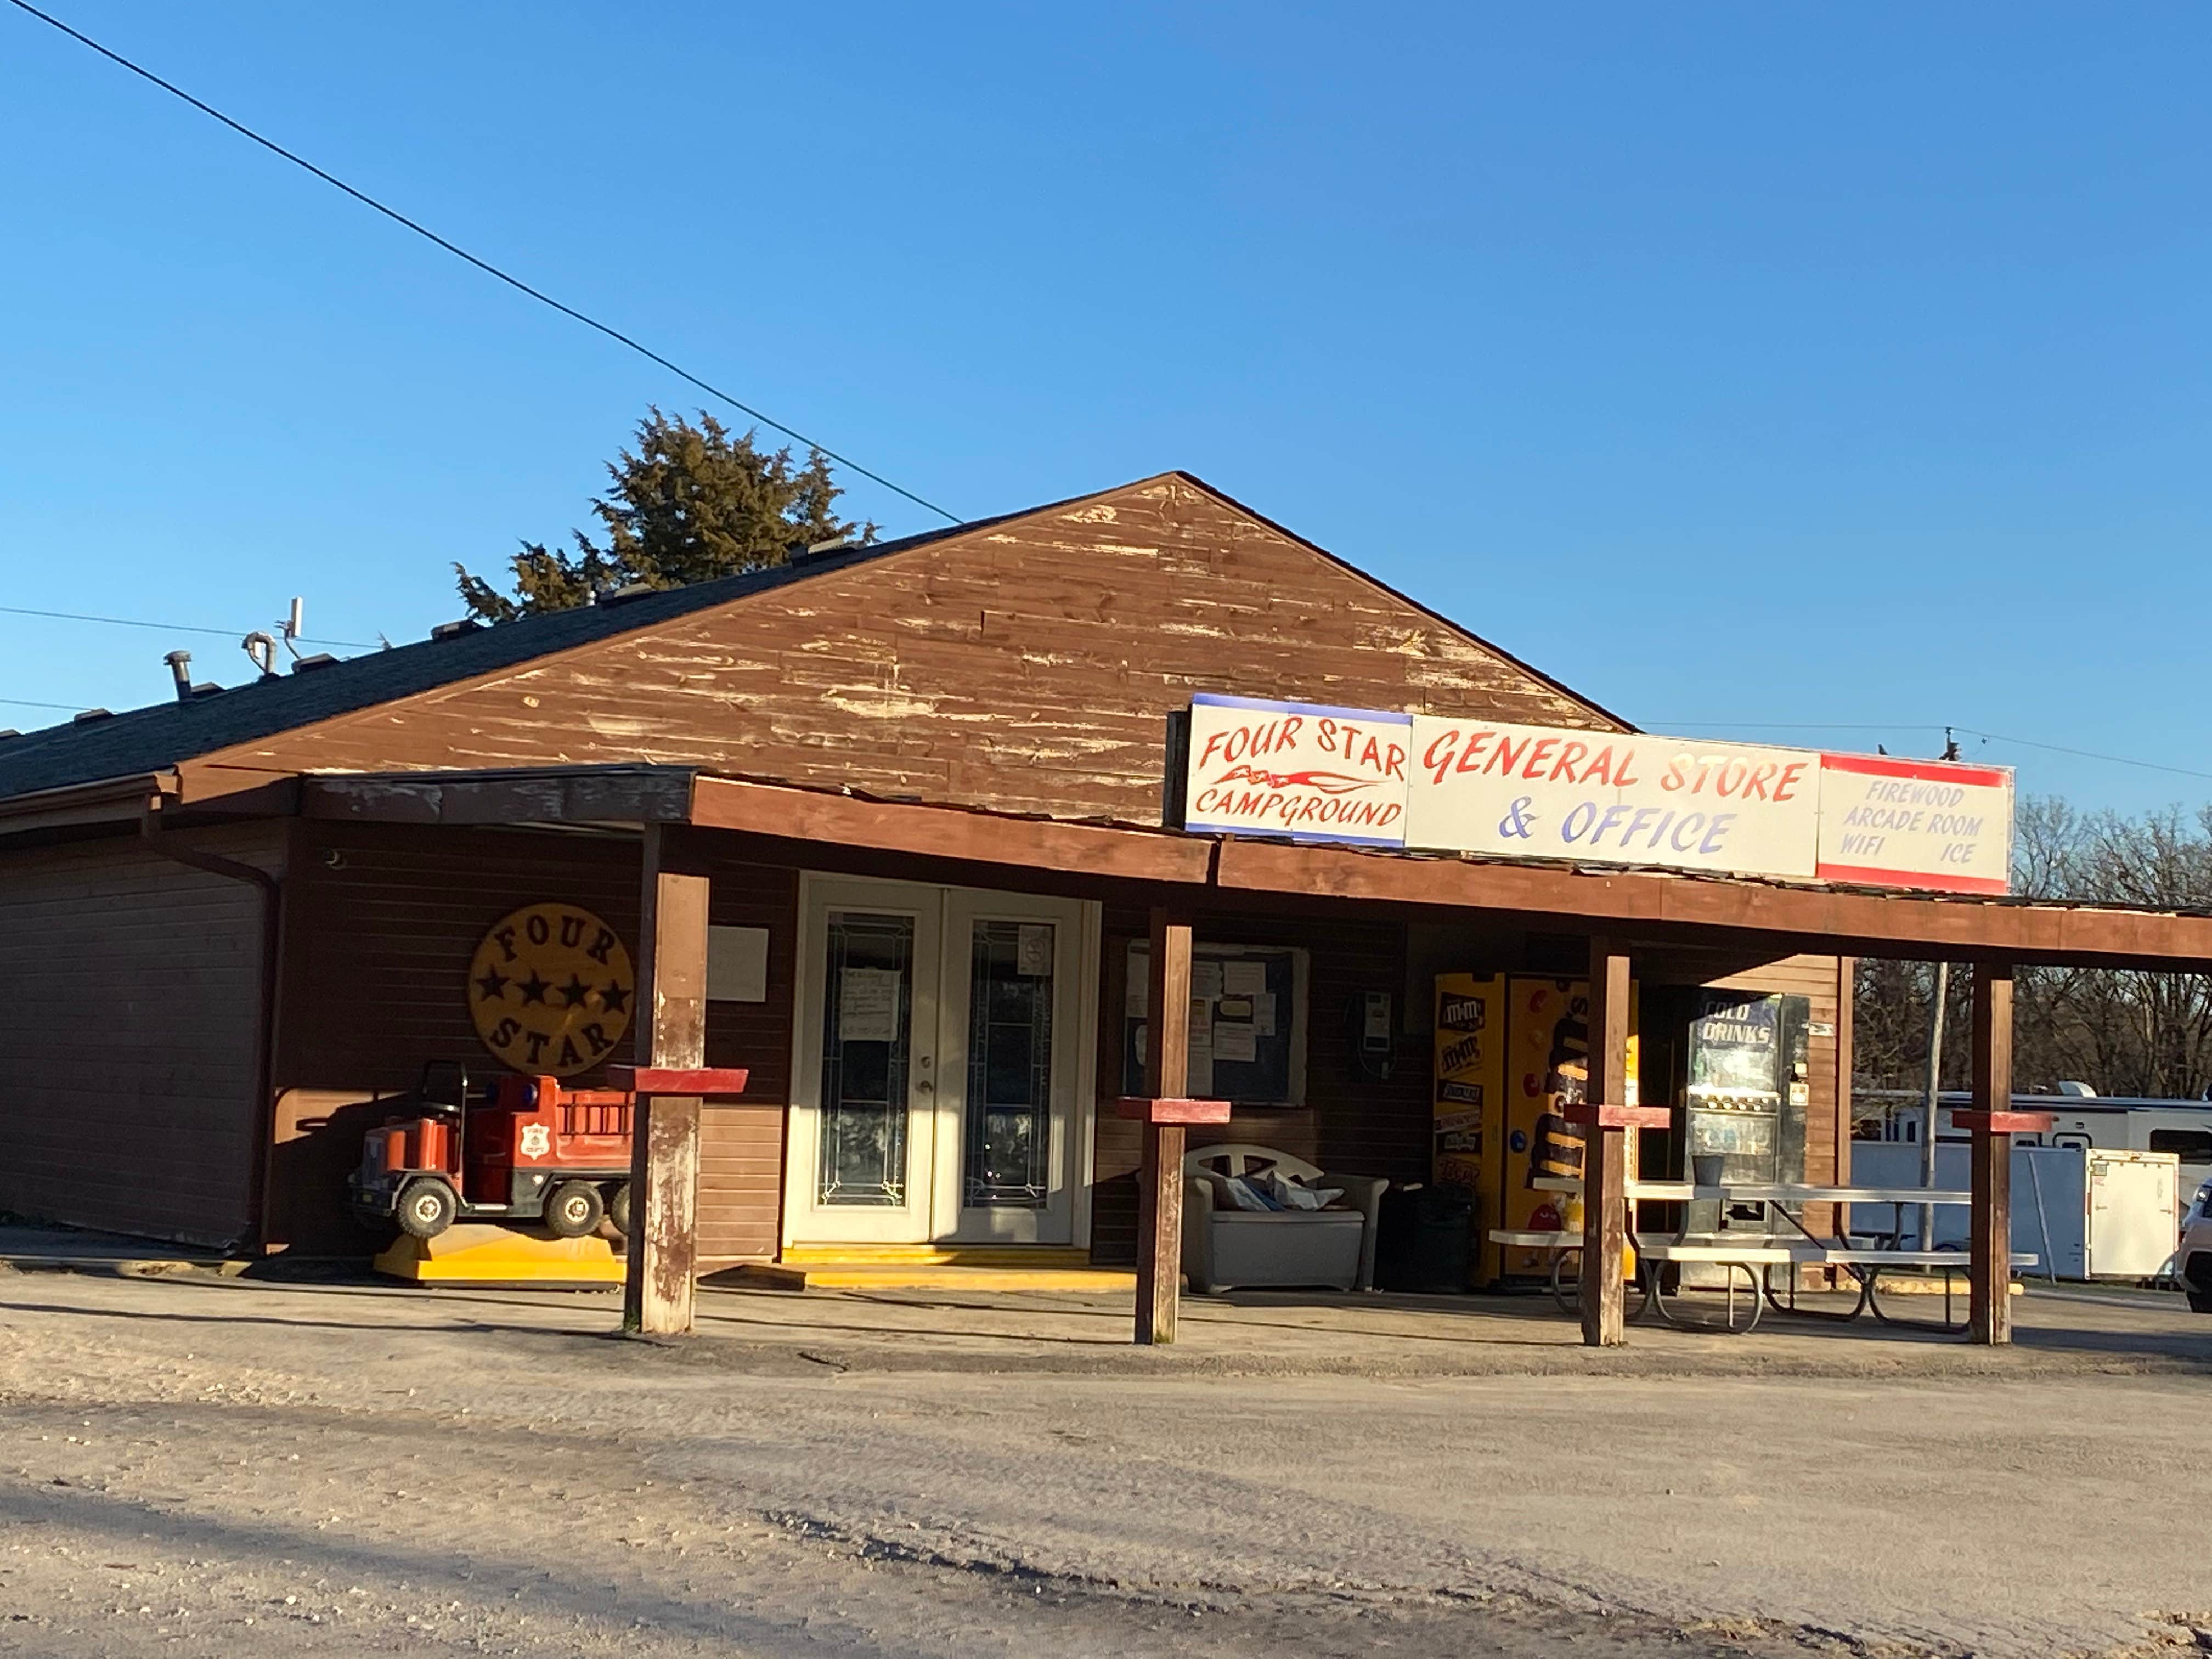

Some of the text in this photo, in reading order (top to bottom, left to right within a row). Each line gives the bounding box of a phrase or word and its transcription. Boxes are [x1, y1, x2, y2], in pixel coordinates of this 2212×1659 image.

[1199, 716, 1406, 783] FOUR STAR
[1424, 730, 1809, 802] GENERAL STORE
[1195, 788, 1402, 827] CAMPGROUND
[1866, 780, 1965, 808] FIREWOOD
[1499, 795, 1738, 854] & OFFICE
[1844, 807, 1983, 838] ARCADE ROOM
[1840, 834, 1977, 865] WIFI ICE
[494, 915, 616, 966] FOUR
[1704, 1001, 1751, 1022] COLD
[489, 1018, 616, 1068] STAR
[1702, 1022, 1771, 1043] DRINKS
